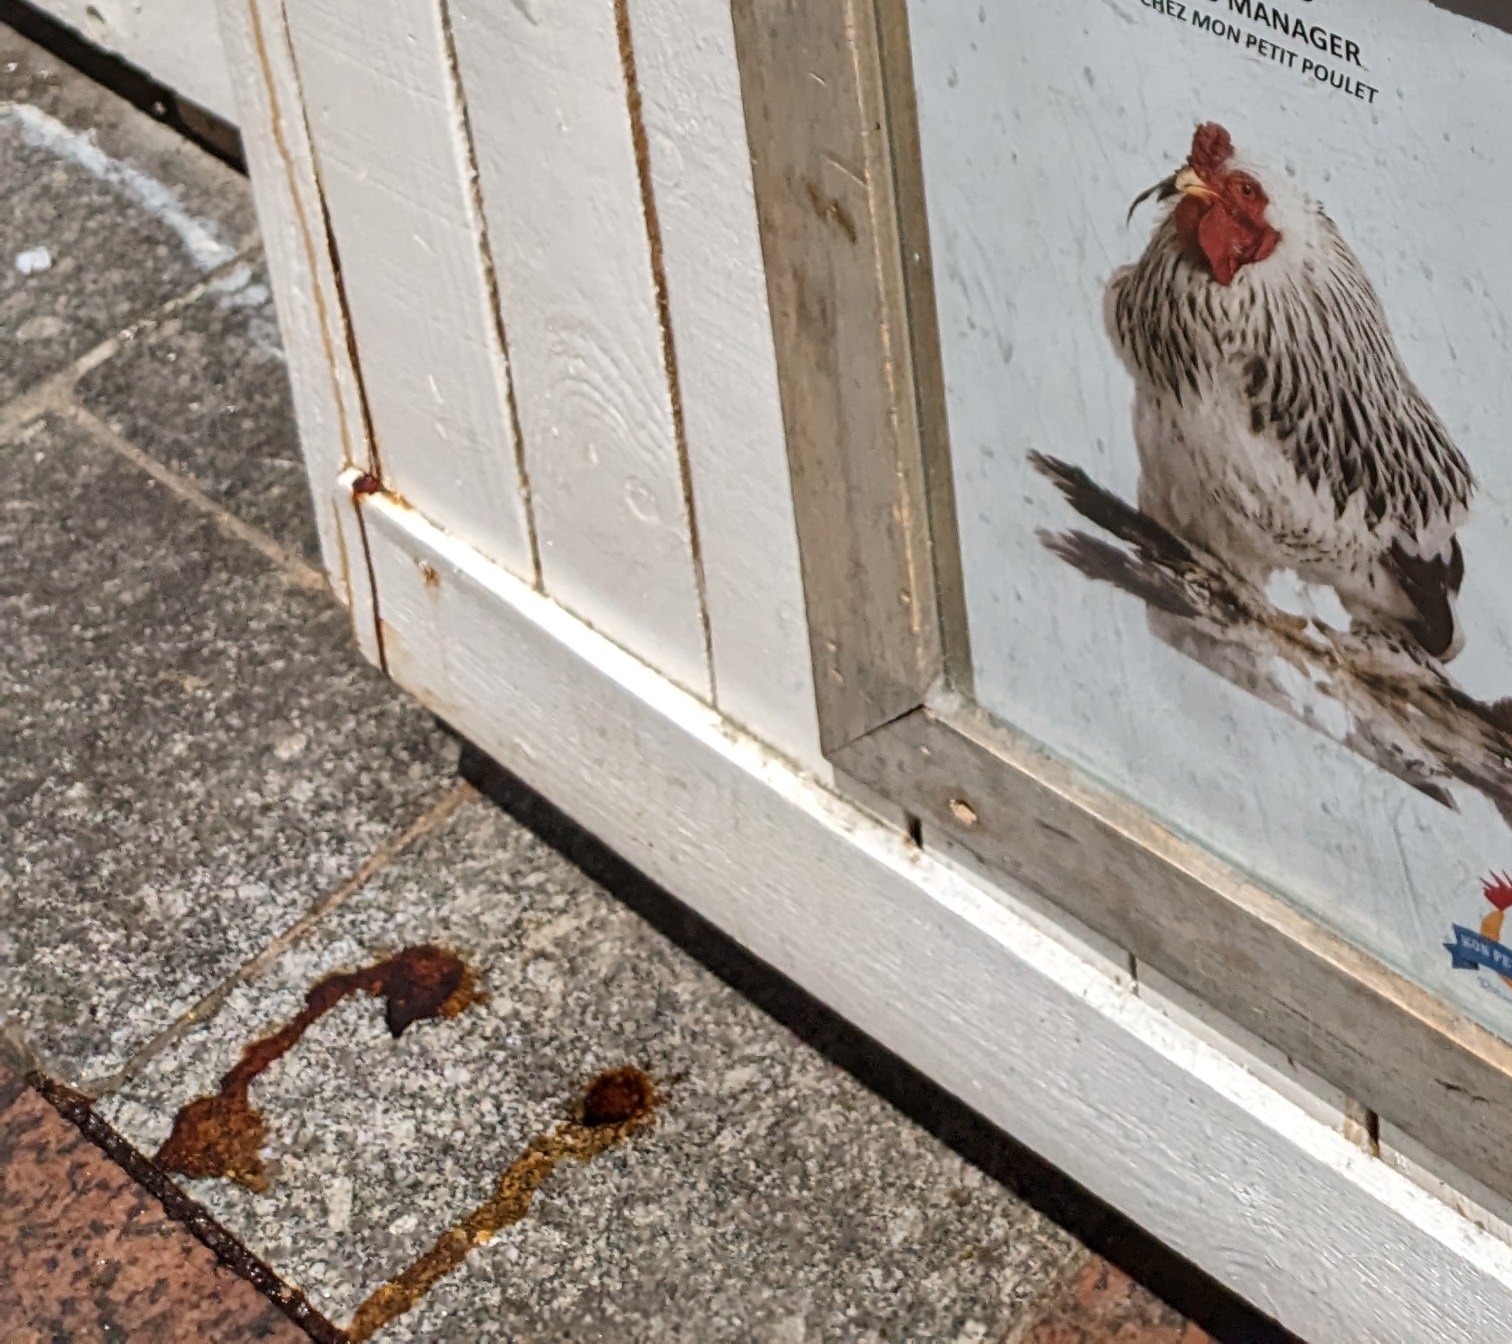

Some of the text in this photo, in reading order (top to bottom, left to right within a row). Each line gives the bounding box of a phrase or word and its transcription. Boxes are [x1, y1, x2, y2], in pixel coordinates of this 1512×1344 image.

[1192, 10, 1240, 44] MON
[1246, 33, 1298, 68] PETIT
[1302, 57, 1379, 104] POULET
